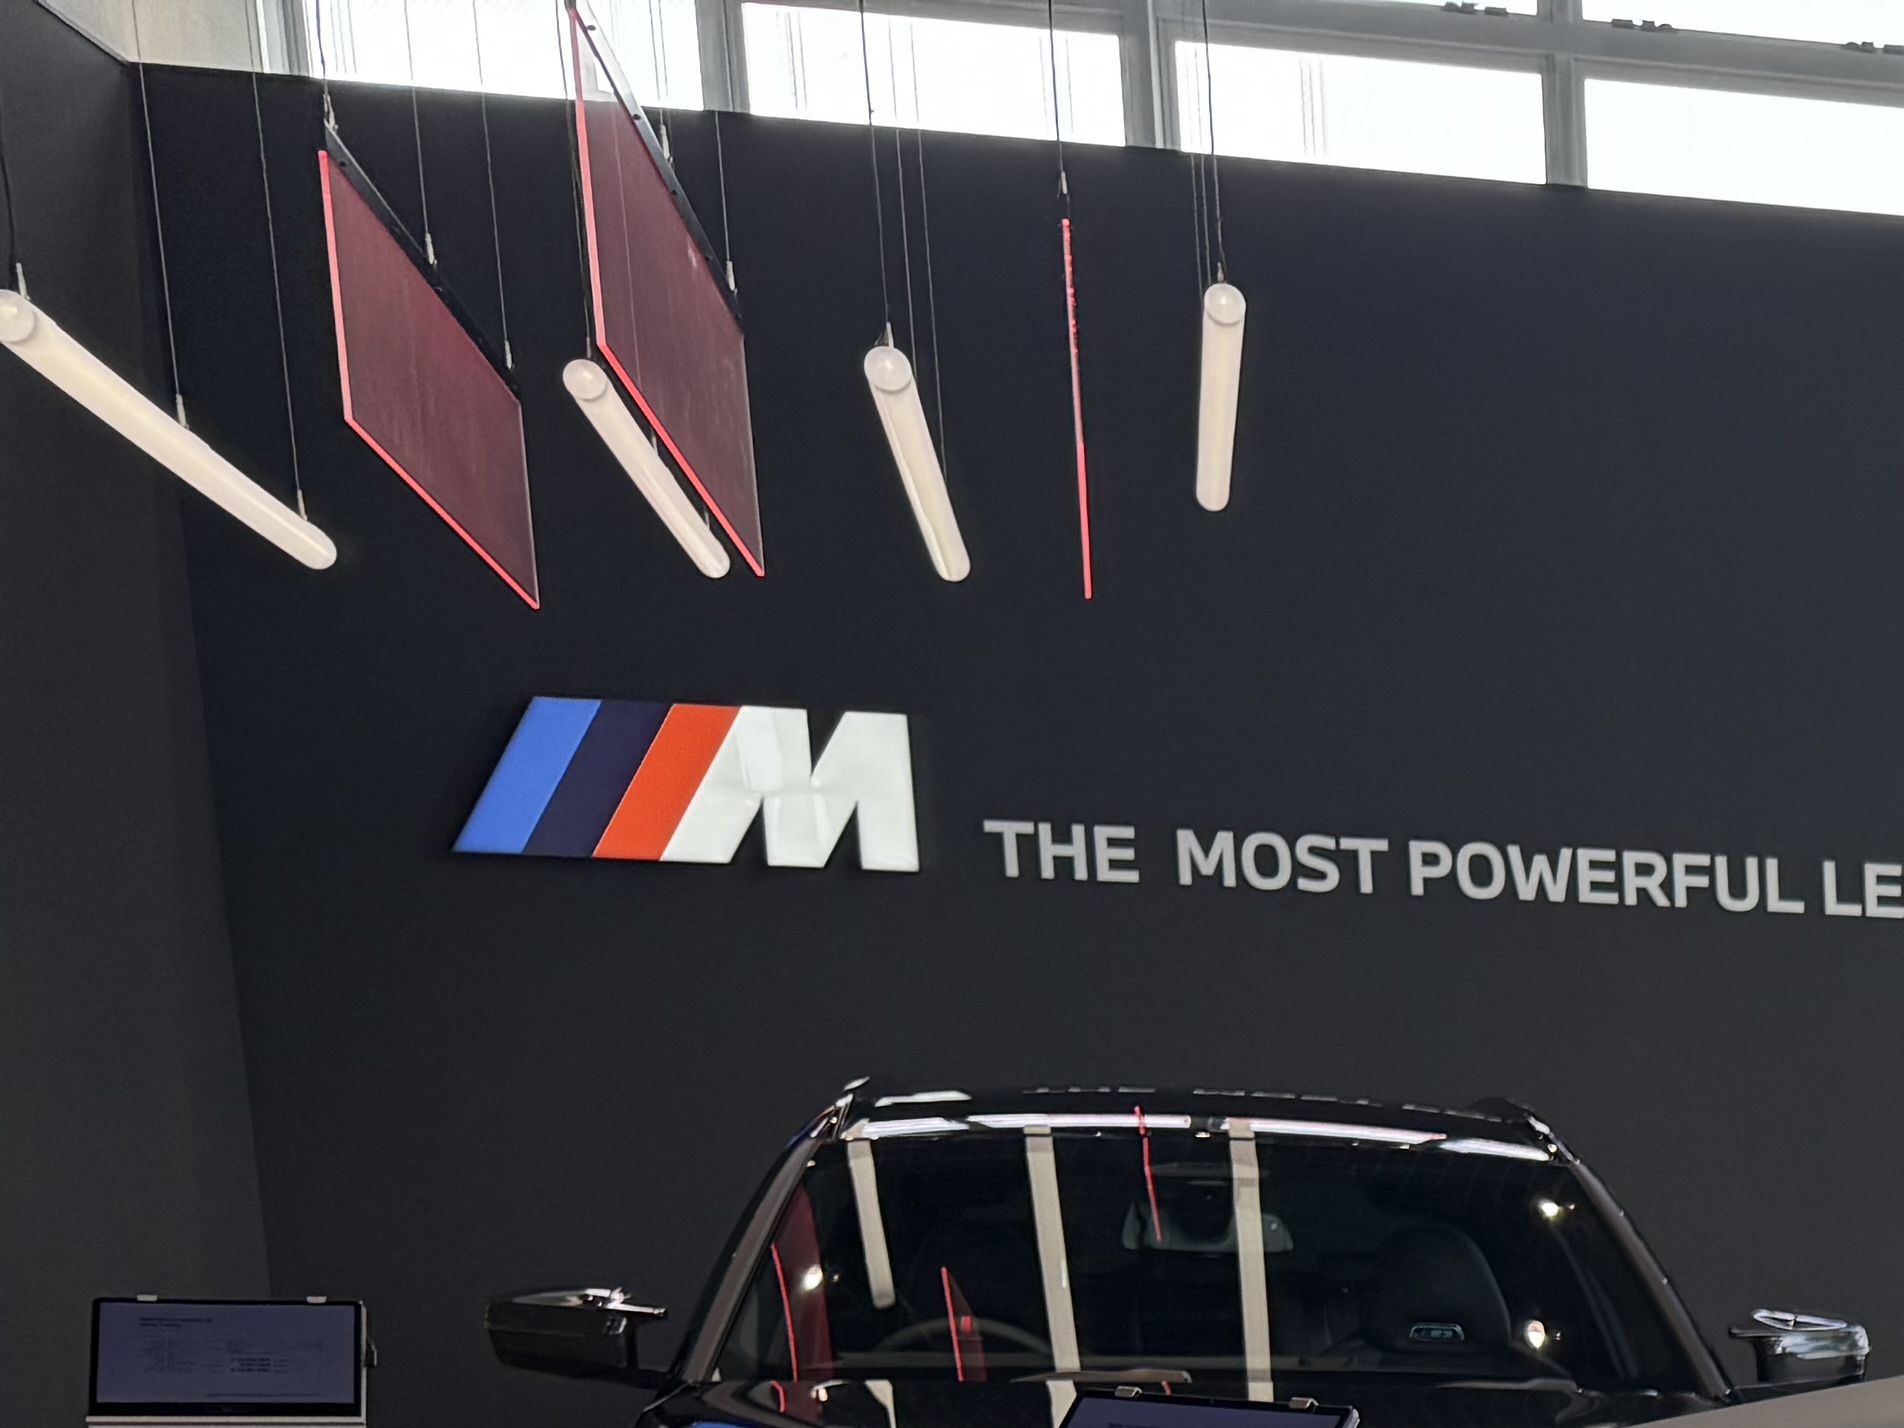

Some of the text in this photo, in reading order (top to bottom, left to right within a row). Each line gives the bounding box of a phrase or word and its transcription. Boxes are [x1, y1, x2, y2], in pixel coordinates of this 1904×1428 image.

[660, 705, 920, 872] M
[983, 819, 1140, 883] THE
[1176, 828, 1389, 894] MOST
[1408, 840, 1805, 914] POWERFUL
